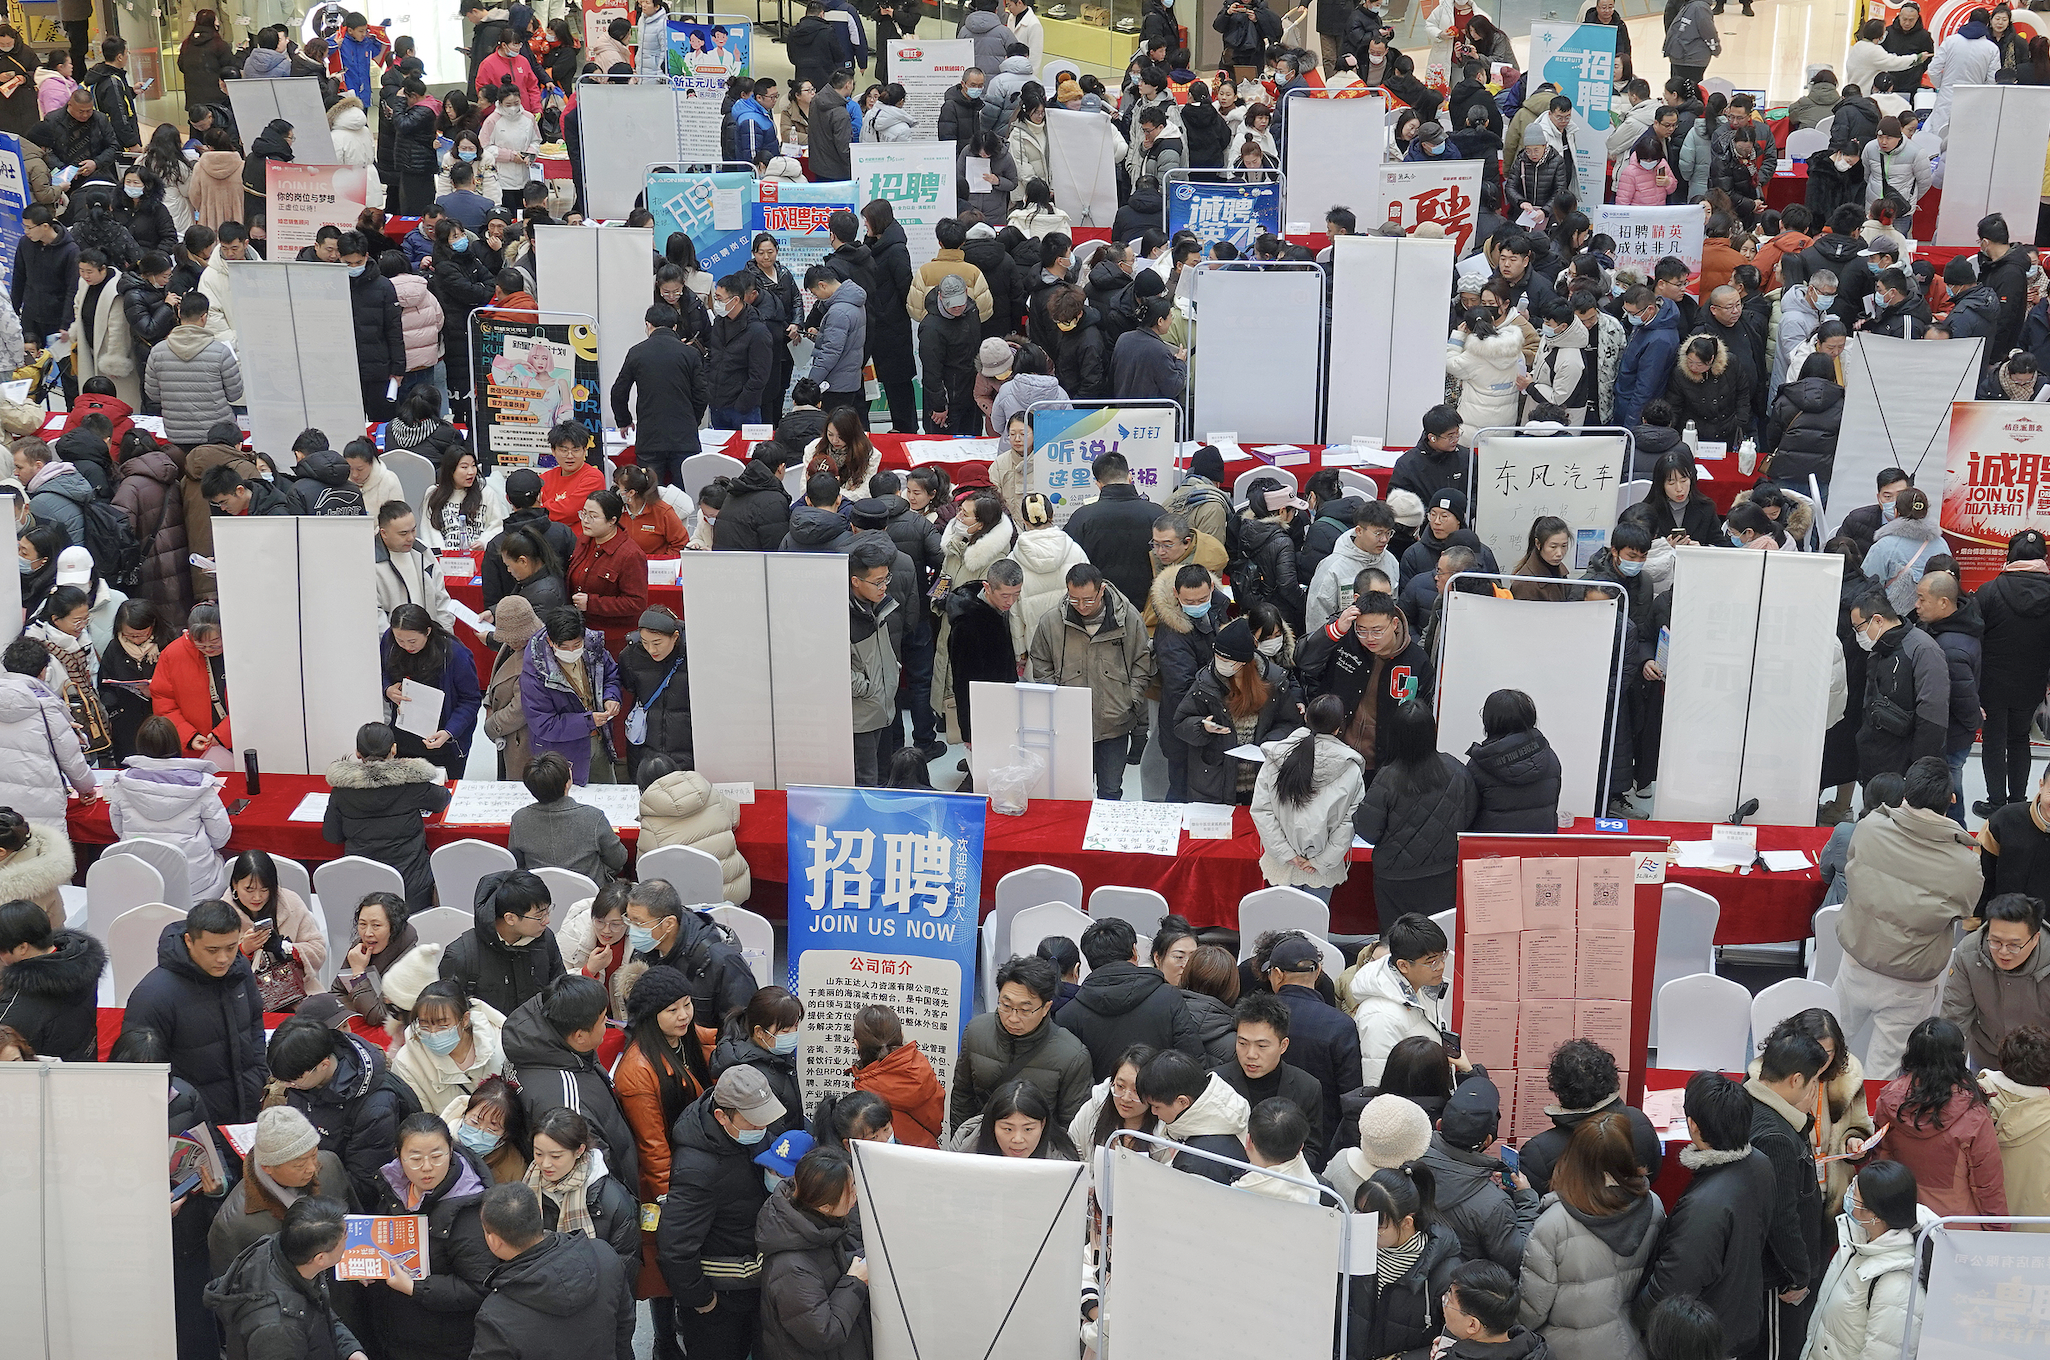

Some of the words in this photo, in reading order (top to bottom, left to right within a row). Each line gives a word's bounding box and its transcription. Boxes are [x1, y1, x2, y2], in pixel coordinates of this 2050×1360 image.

[277, 192, 336, 204] 你的岗位与梦想
[869, 172, 941, 204] 招聘
[764, 206, 851, 236] 诚聘英
[1189, 196, 1257, 225] 诚聘
[1619, 224, 1683, 240] 招聘精英
[711, 235, 750, 265] 招聘岗位
[1617, 241, 1683, 255] 成就非凡
[1133, 426, 1161, 440] 钉钉
[1494, 460, 1614, 497] 东风汽车
[1965, 487, 2002, 502] JOIN
[2007, 489, 2025, 504] US
[1964, 502, 2022, 517] 加入我们
[805, 825, 954, 917] 招聘
[953, 838, 969, 922] 欢迎您的加入
[809, 914, 858, 933] JOIN
[869, 917, 896, 937] US
[906, 920, 956, 942] NOW
[850, 956, 913, 976] 公司简介
[826, 977, 949, 996] 山东正达人力资源有限公司成立
[407, 1219, 416, 1244] GEDU
[348, 1258, 383, 1276] 雅思
